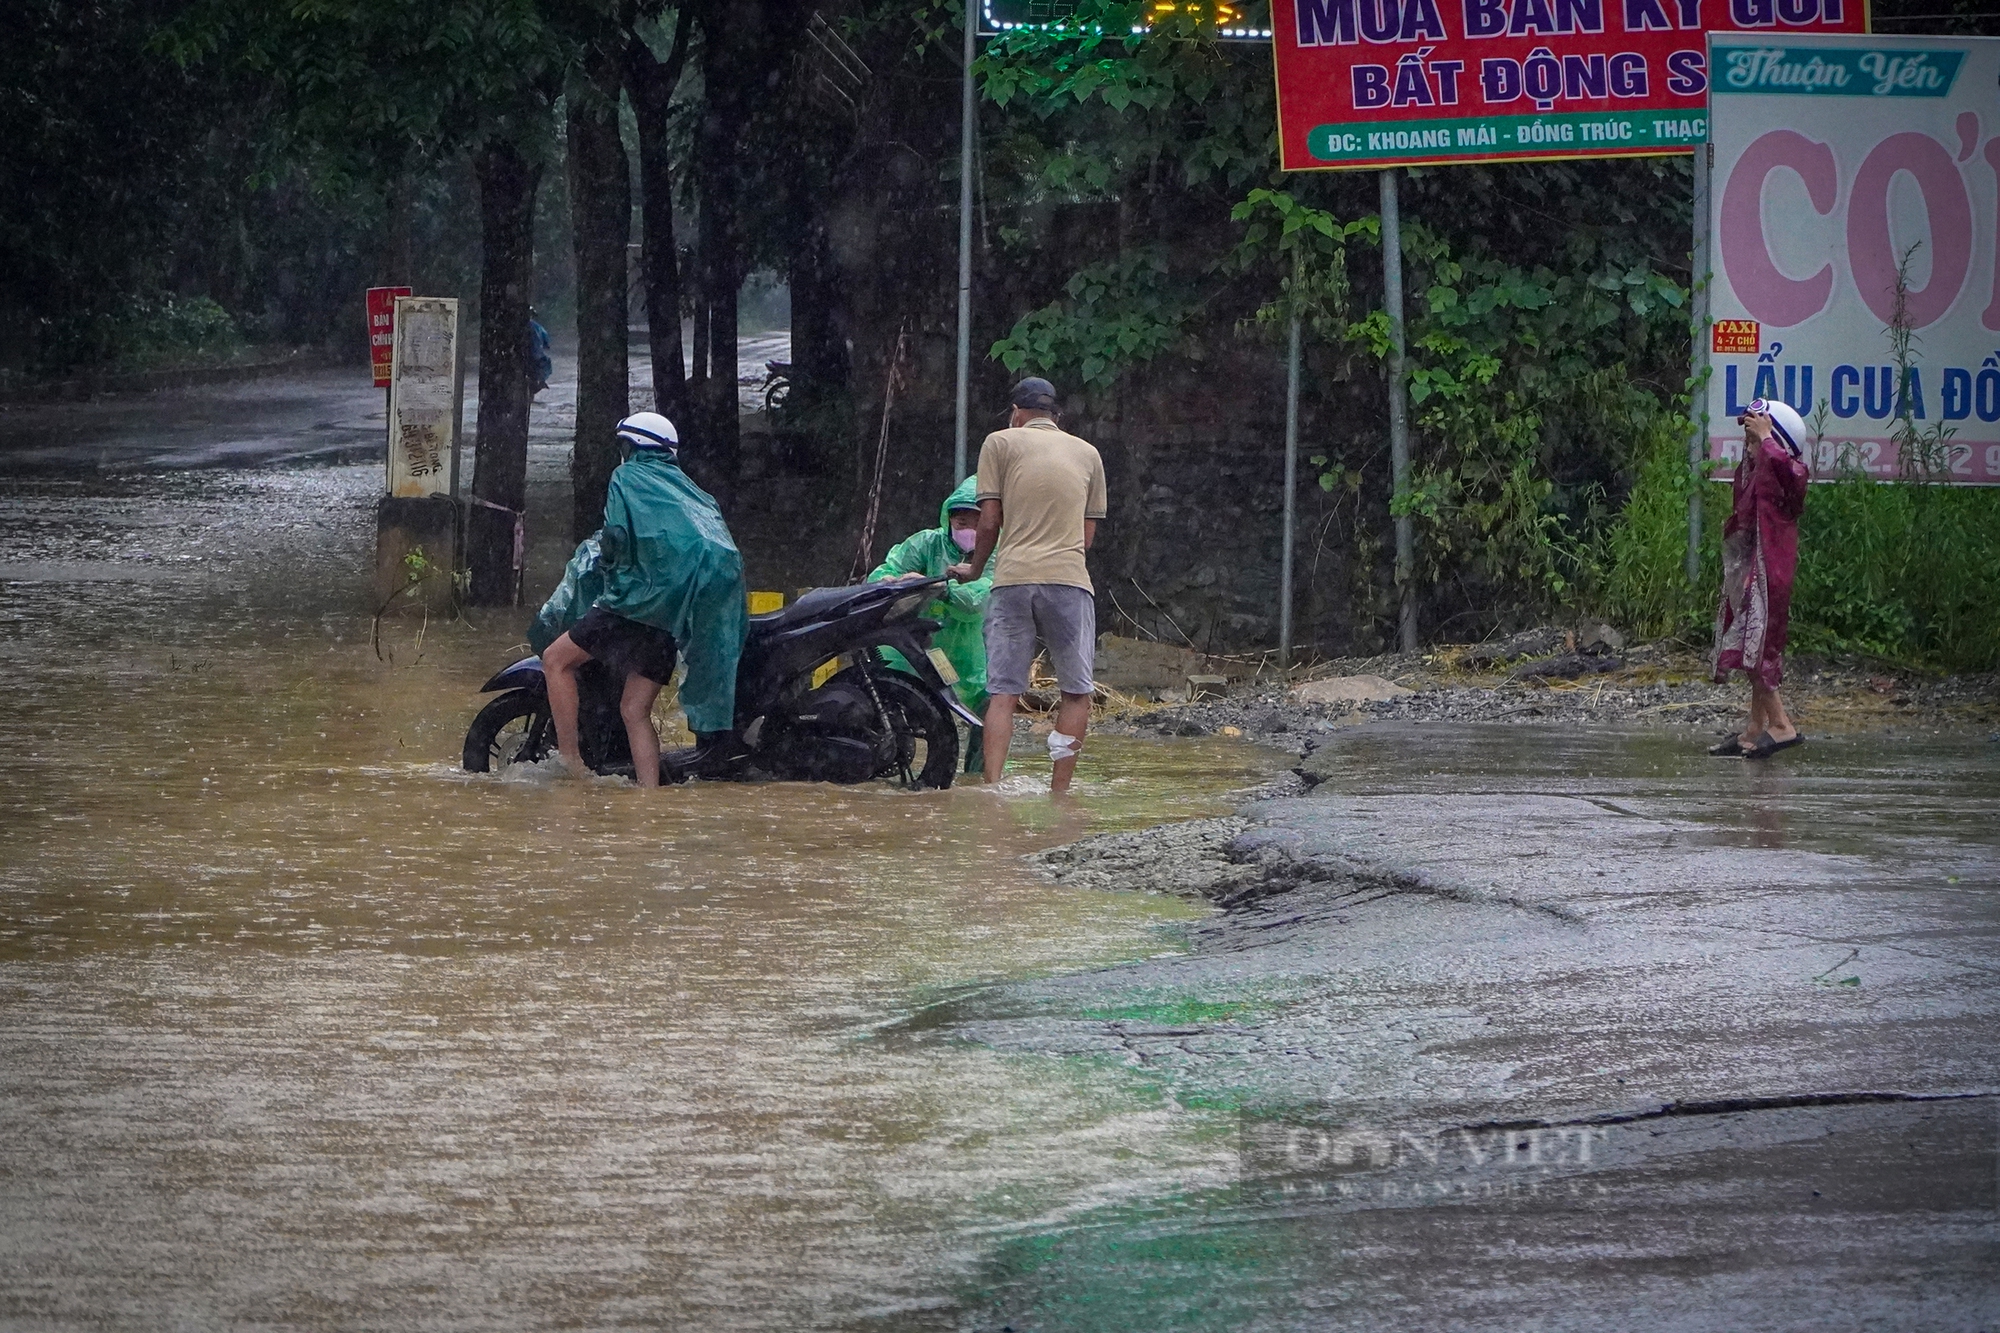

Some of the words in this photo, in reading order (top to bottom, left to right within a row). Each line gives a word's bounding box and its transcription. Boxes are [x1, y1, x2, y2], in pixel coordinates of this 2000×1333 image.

[1350, 46, 1465, 110] BẤT
[1479, 47, 1650, 111] ĐỘNG
[1726, 48, 1852, 92] Thuận
[1858, 52, 1945, 95] Yến
[1328, 134, 1362, 152] ĐC:
[1368, 131, 1450, 150] KHOANG
[1457, 124, 1496, 146] MÁI
[1517, 119, 1574, 143] ĐỒNG
[1580, 118, 1632, 141] TRÚC
[1652, 119, 1707, 141] THẠC
[1720, 112, 2000, 332] CƠ
[1718, 321, 1757, 333] TAXI
[1724, 341, 1813, 418] LẨU
[1831, 364, 1926, 420] CUA
